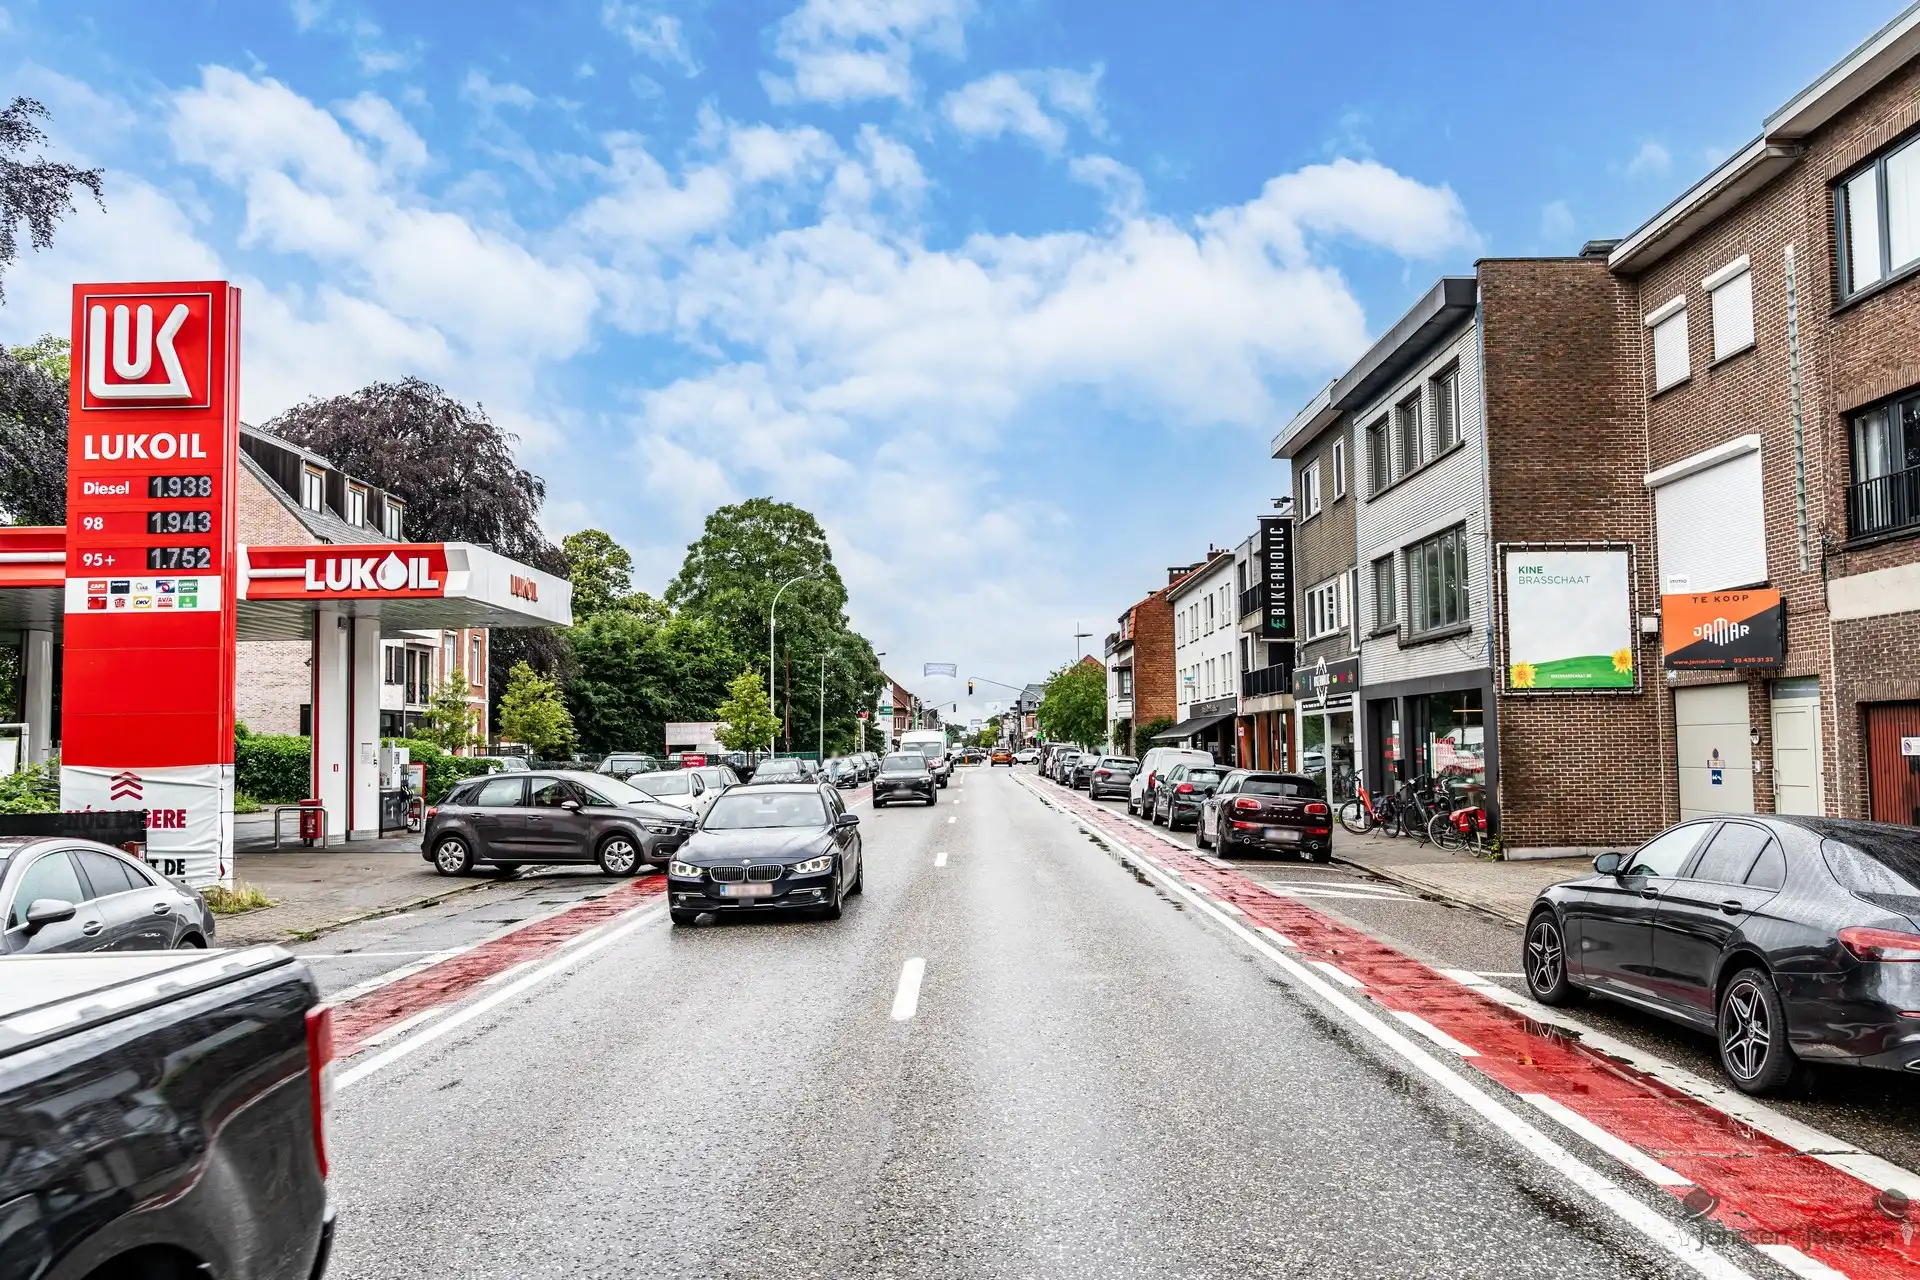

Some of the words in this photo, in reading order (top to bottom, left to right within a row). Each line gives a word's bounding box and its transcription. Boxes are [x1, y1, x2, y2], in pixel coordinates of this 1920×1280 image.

[84, 433, 207, 460] LUKOIL
[83, 481, 130, 495] Diesel
[152, 476, 212, 497] 1.938
[83, 517, 104, 530] 98
[151, 512, 211, 533] 1.943
[82, 553, 116, 567] 95+
[151, 548, 211, 569] 1.752
[305, 551, 440, 591] LUKOIL
[1518, 565, 1544, 574] KINE
[1518, 575, 1591, 585] BRASSCHAAT
[510, 574, 539, 602] LUKOIL
[1714, 594, 1749, 603] KOOP
[1693, 617, 1750, 646] JAMAR
[165, 859, 186, 875] DE
